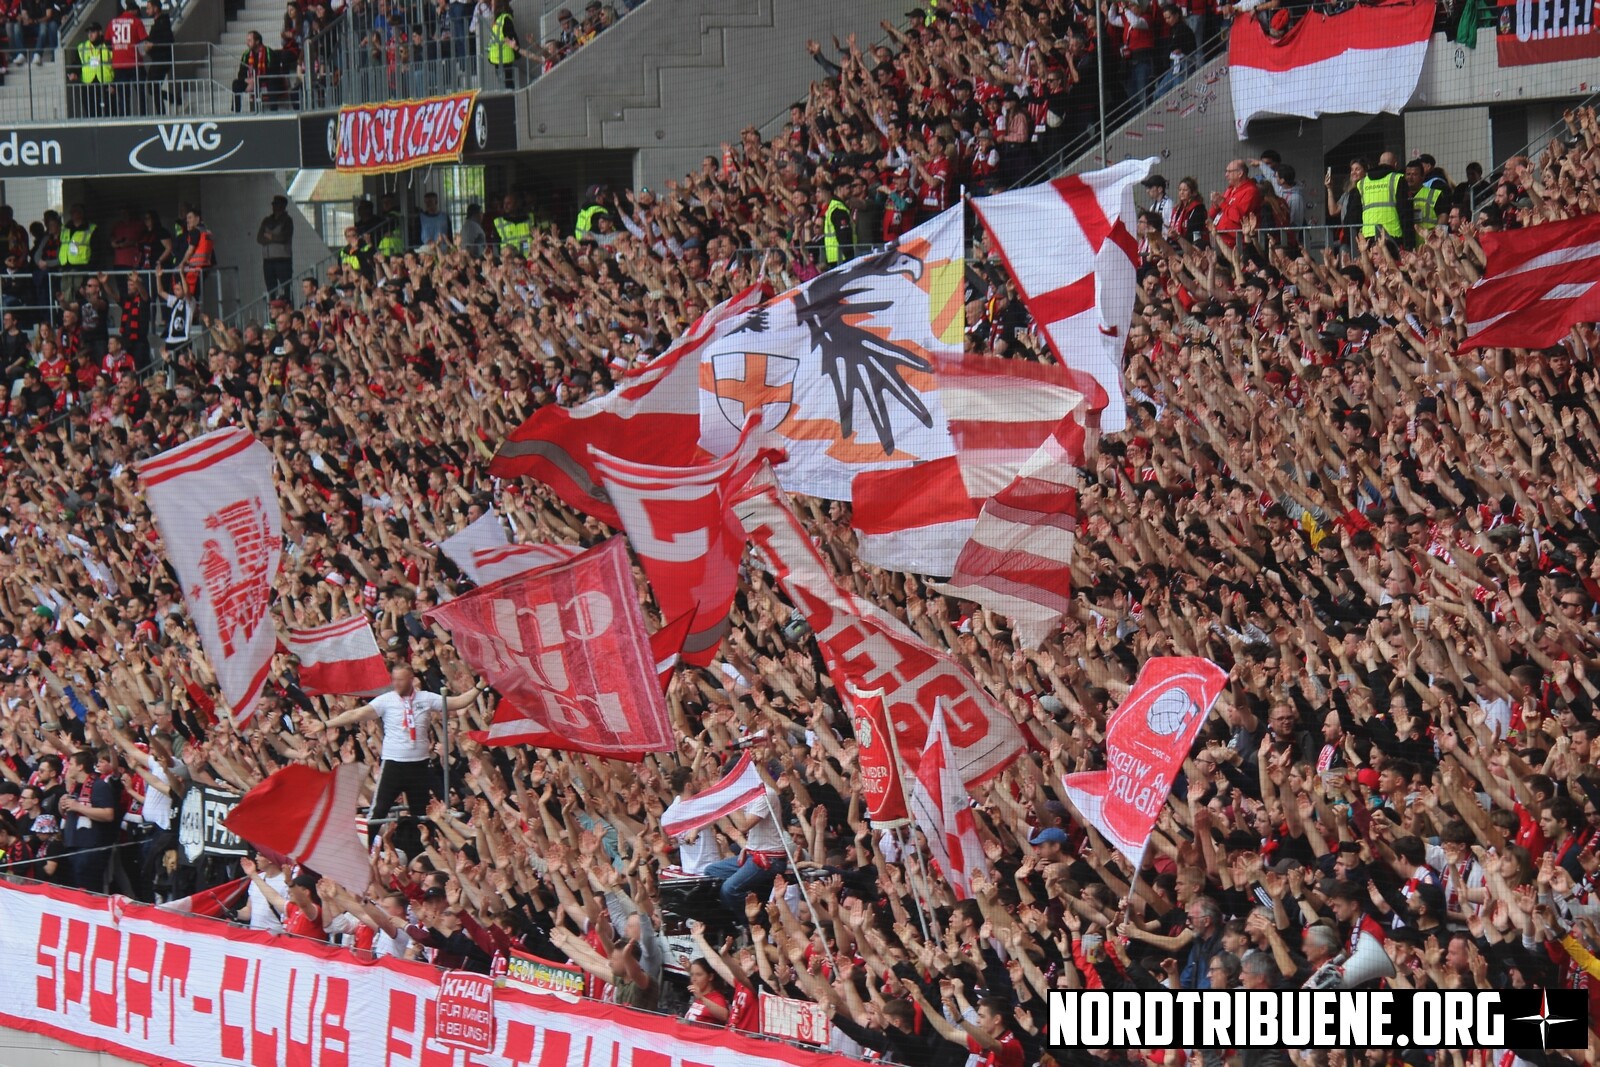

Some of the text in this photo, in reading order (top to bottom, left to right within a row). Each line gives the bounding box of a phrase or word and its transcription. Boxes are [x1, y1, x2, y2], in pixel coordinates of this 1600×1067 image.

[112, 24, 131, 44] 30
[157, 122, 221, 151] VAG
[36, 911, 350, 1067] SPORT-CLUB
[440, 1000, 460, 1018] FÜR
[446, 1021, 482, 1041] BEI UNS
